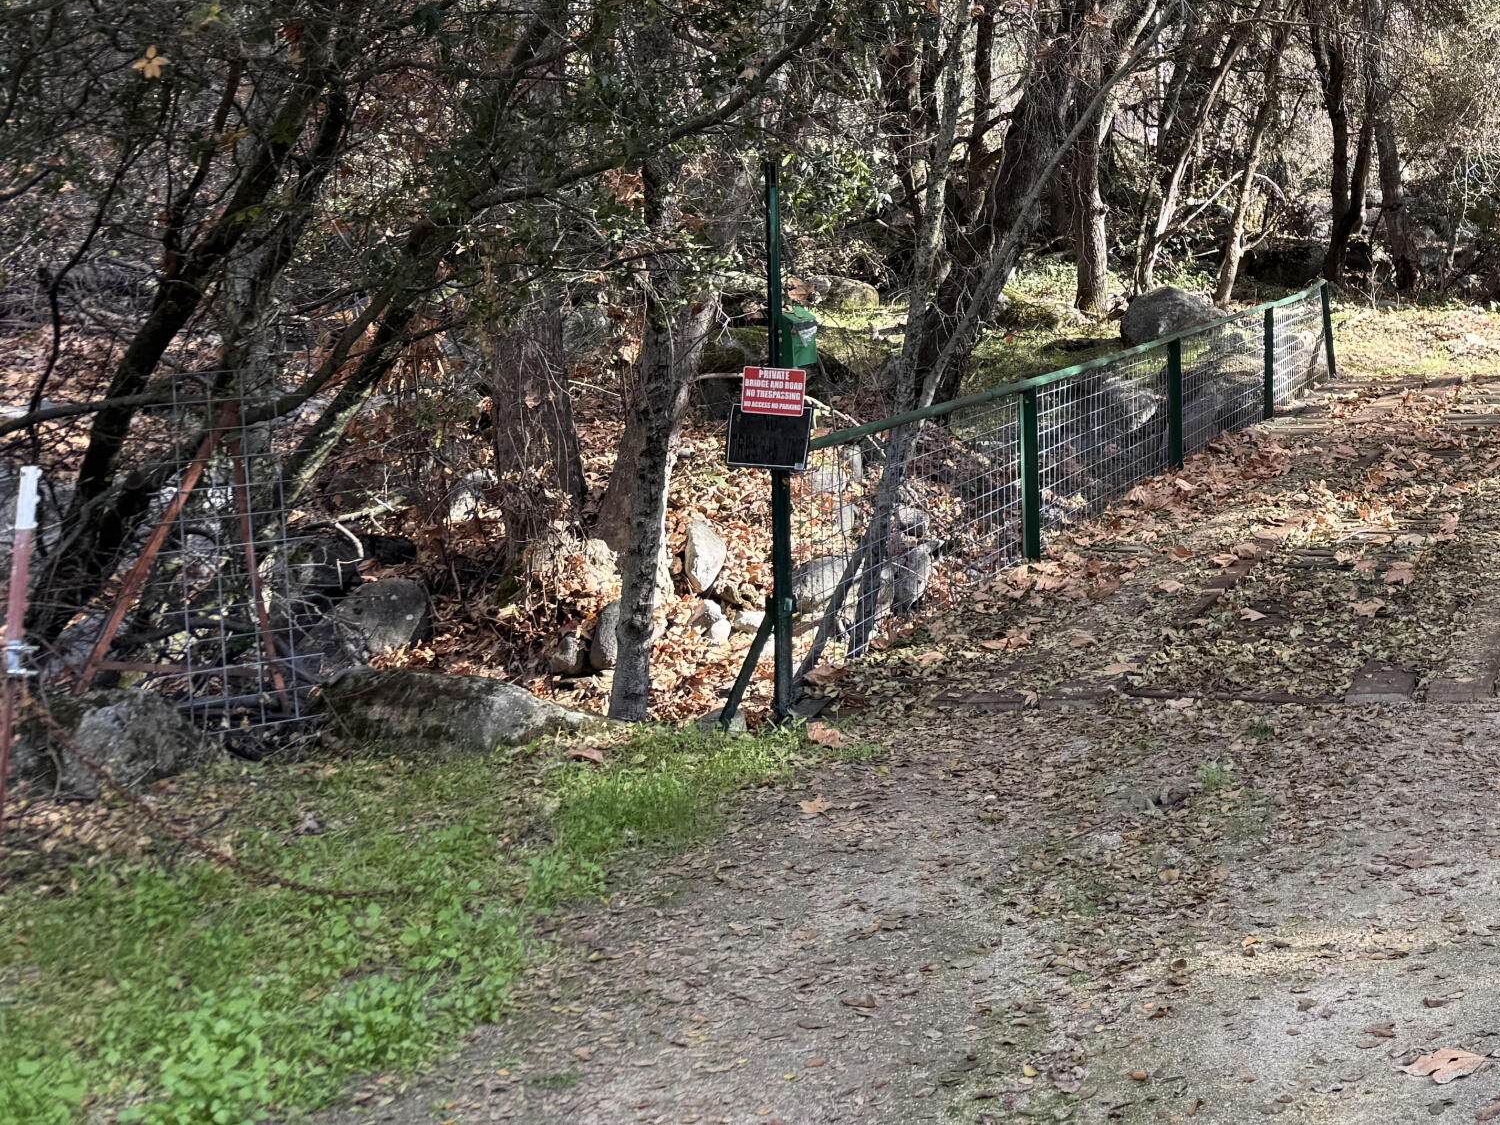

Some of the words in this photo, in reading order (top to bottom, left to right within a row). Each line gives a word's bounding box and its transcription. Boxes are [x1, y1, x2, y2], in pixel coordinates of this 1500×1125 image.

[758, 369, 790, 380] PRIVATE
[745, 379, 769, 388] BRIDGE
[770, 380, 784, 389] AND
[784, 381, 803, 391] ROAD
[746, 389, 756, 397] NO
[756, 390, 801, 401] TRESPASSING
